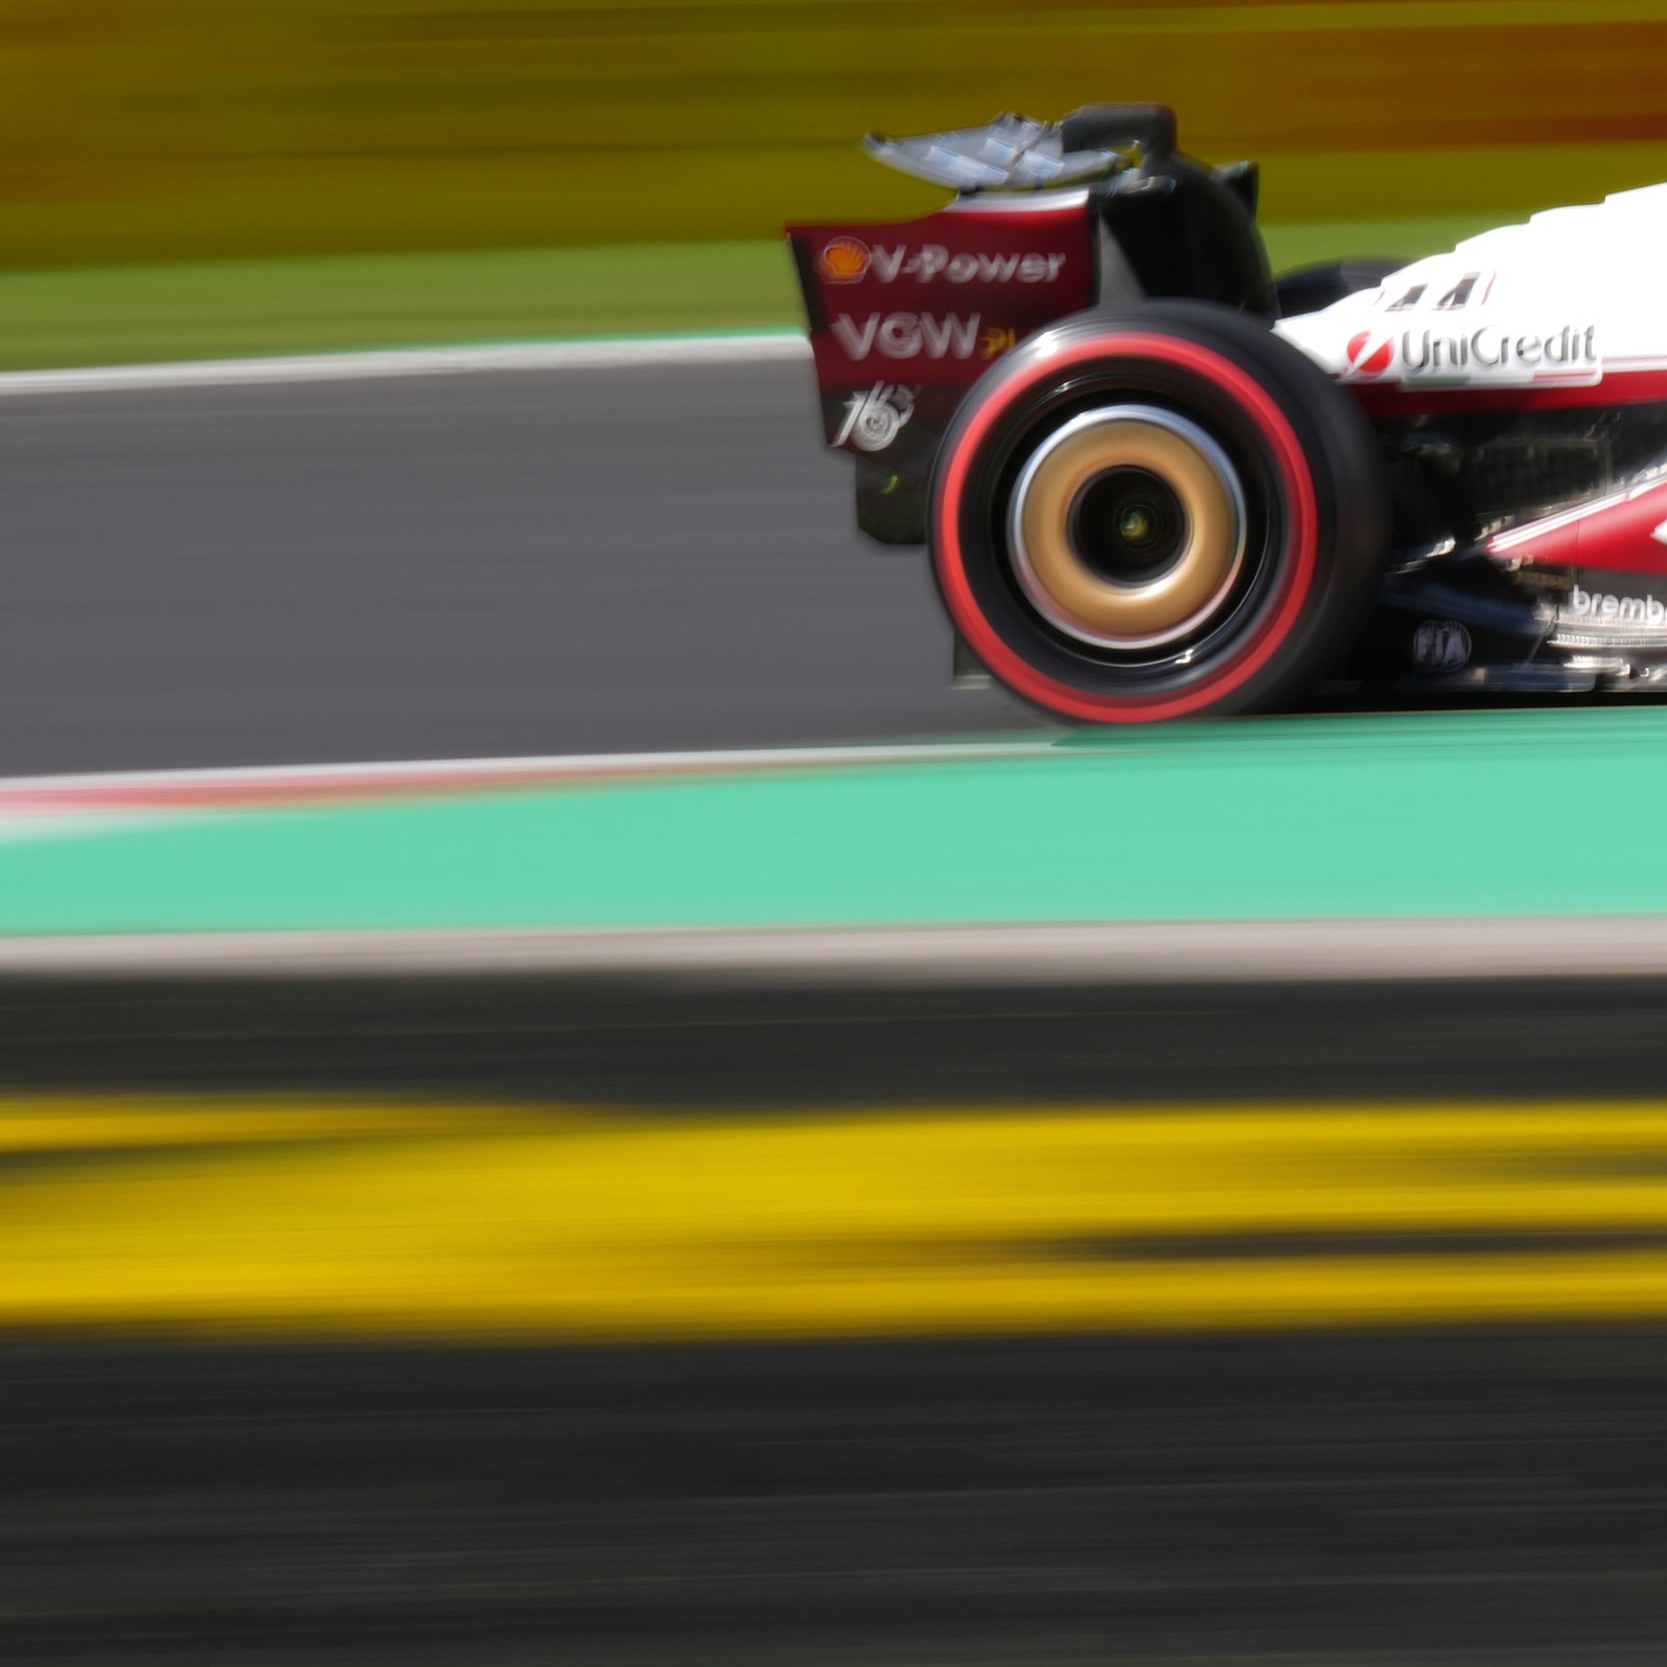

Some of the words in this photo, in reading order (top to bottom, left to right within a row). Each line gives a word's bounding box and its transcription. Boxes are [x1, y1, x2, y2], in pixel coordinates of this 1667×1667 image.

[872, 243, 1067, 283] V-Power
[832, 312, 981, 360] VGW
[1402, 325, 1597, 368] UniCredit
